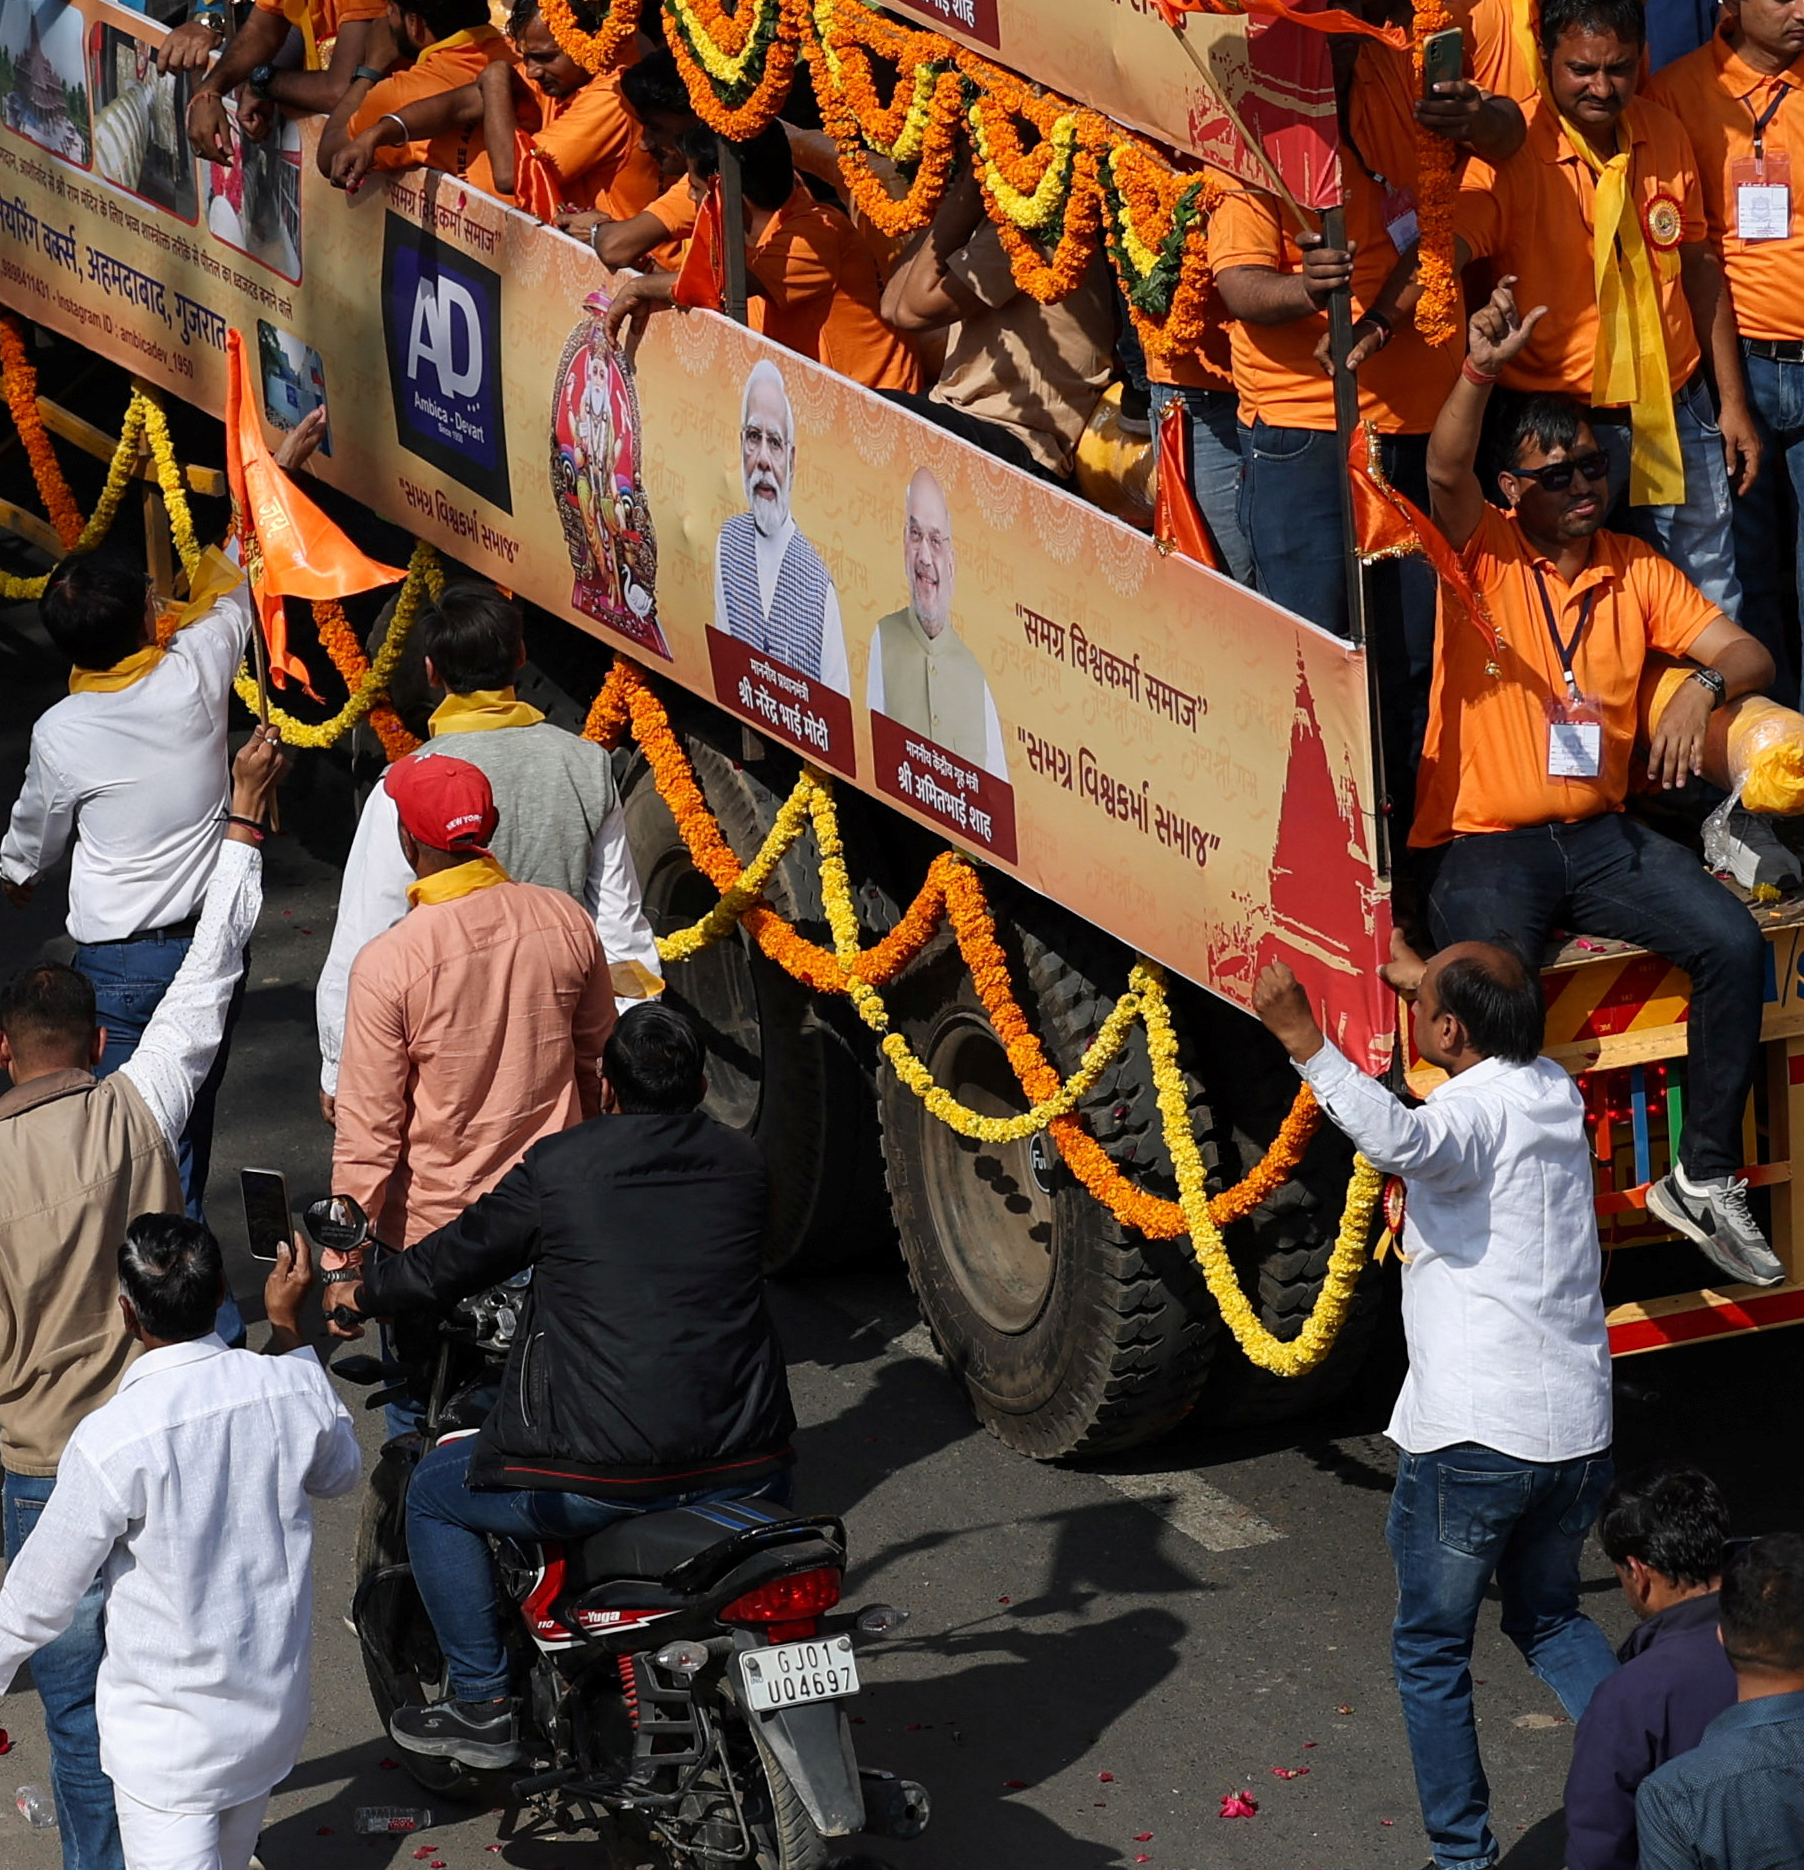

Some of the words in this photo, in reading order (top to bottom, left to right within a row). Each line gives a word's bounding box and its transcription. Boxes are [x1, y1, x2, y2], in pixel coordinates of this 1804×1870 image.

[57, 290, 101, 327] Instagram
[102, 312, 113, 333] ID
[85, 244, 173, 330] अहमदाबाद,
[174, 291, 227, 353] गुजरात
[407, 274, 483, 400] AD
[414, 391, 448, 423] Ambica
[455, 411, 485, 443] Devart
[749, 658, 777, 690] माननीय
[777, 671, 809, 703] प्रधानमंत्री
[1070, 622, 1140, 703] विश्वकर्मा
[738, 676, 753, 710] श्री
[754, 685, 778, 727] नरेंद्र
[779, 699, 802, 741] भाई
[803, 712, 829, 752] मोदी
[906, 739, 932, 770] माननीय
[932, 749, 953, 778] केंद्रीय
[953, 765, 965, 790] गृह
[966, 767, 979, 793] मंत्री
[1079, 746, 1149, 835] વિશ્વકર્મા
[898, 761, 913, 795] श्री
[915, 773, 967, 829] अमितभाई
[969, 803, 992, 842] शाह
[537, 1620, 555, 1629] 110
[588, 1610, 621, 1623] Yuga
[777, 1643, 834, 1673] GJ01
